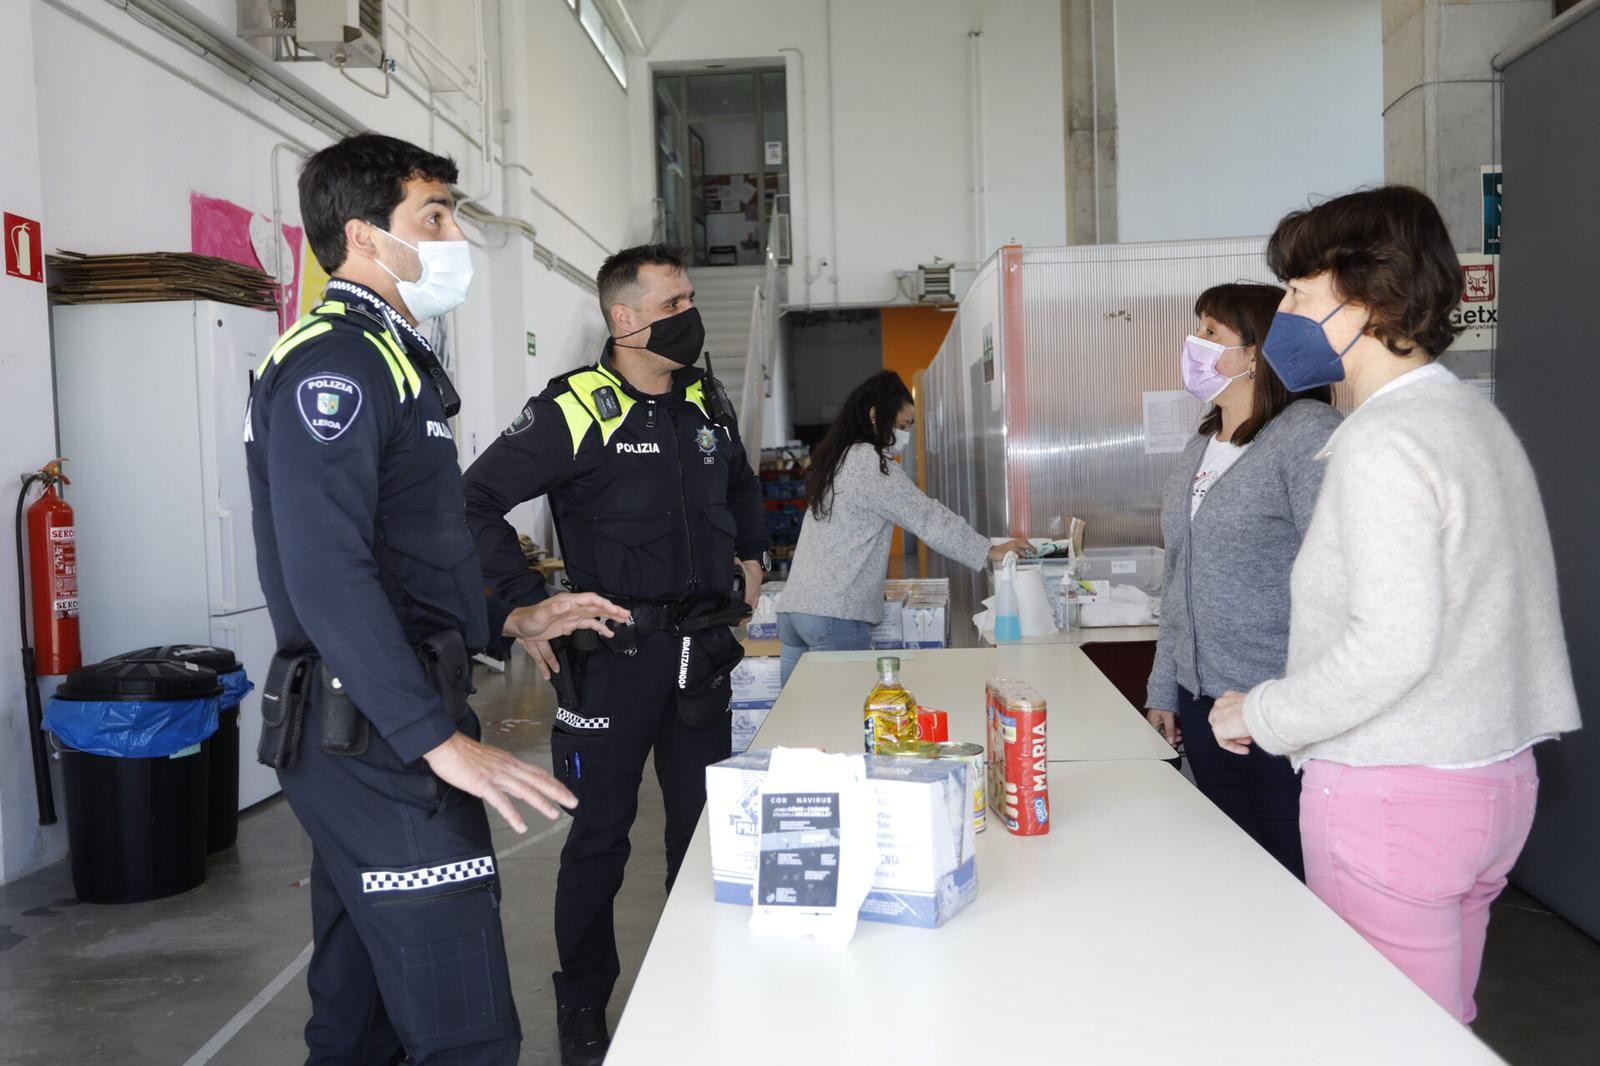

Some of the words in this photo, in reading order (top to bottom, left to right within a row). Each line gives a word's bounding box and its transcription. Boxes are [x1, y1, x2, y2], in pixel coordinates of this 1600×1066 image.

[1449, 304, 1498, 324] Getx
[308, 379, 353, 394] POLIZIA
[616, 442, 660, 454] POLIZIA
[1032, 720, 1047, 792] MARIA
